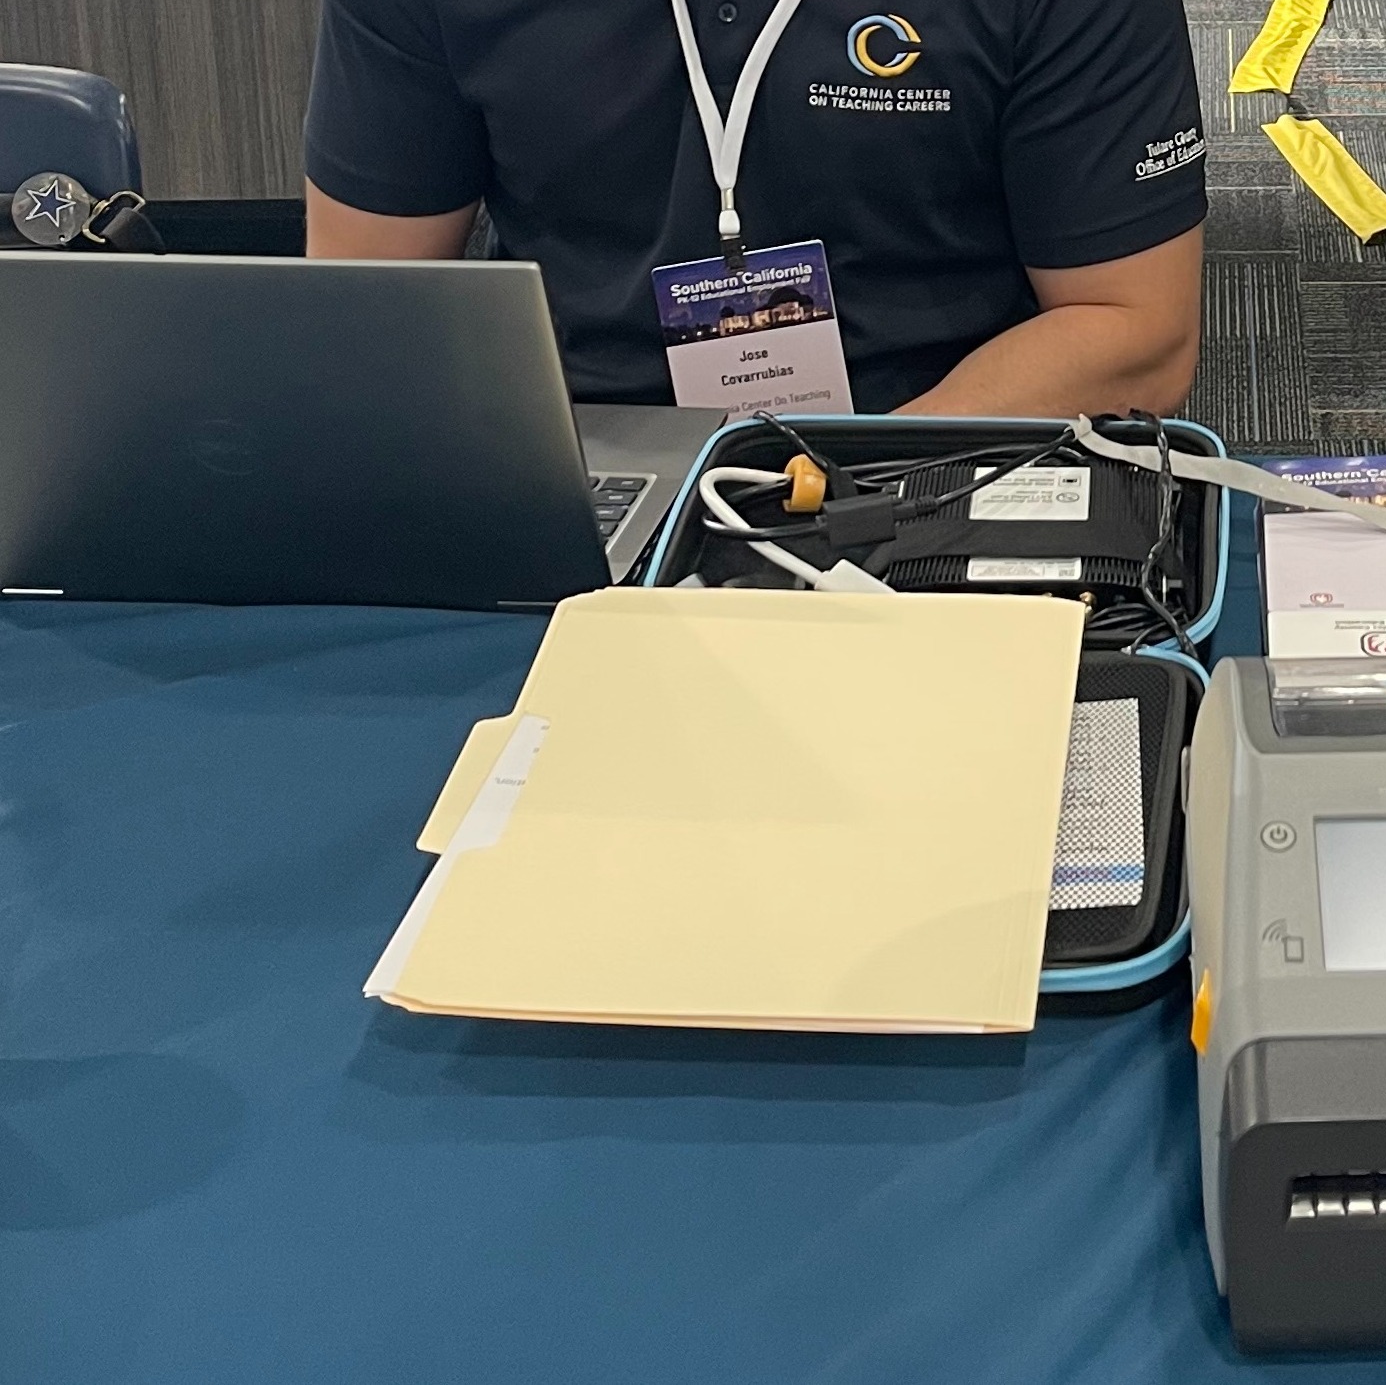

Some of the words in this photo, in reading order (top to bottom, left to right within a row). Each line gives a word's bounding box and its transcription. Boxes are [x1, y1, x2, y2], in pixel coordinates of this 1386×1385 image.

[809, 83, 894, 100] CALIFORNIA
[896, 89, 951, 100] CENTER
[808, 95, 828, 107] ON
[831, 96, 894, 111] TEACHING
[896, 101, 951, 112] CAREERS
[1145, 139, 1175, 158] Tulare
[1135, 158, 1166, 176] Office
[1166, 150, 1177, 166] of
[670, 276, 738, 297] Southern
[741, 263, 813, 285] California
[700, 287, 746, 301] Educational
[739, 349, 769, 363] Jose
[721, 365, 795, 387] Covarrubias
[741, 399, 772, 412] Center
[789, 389, 831, 404] Teaching
[1281, 469, 1362, 482] Southern
